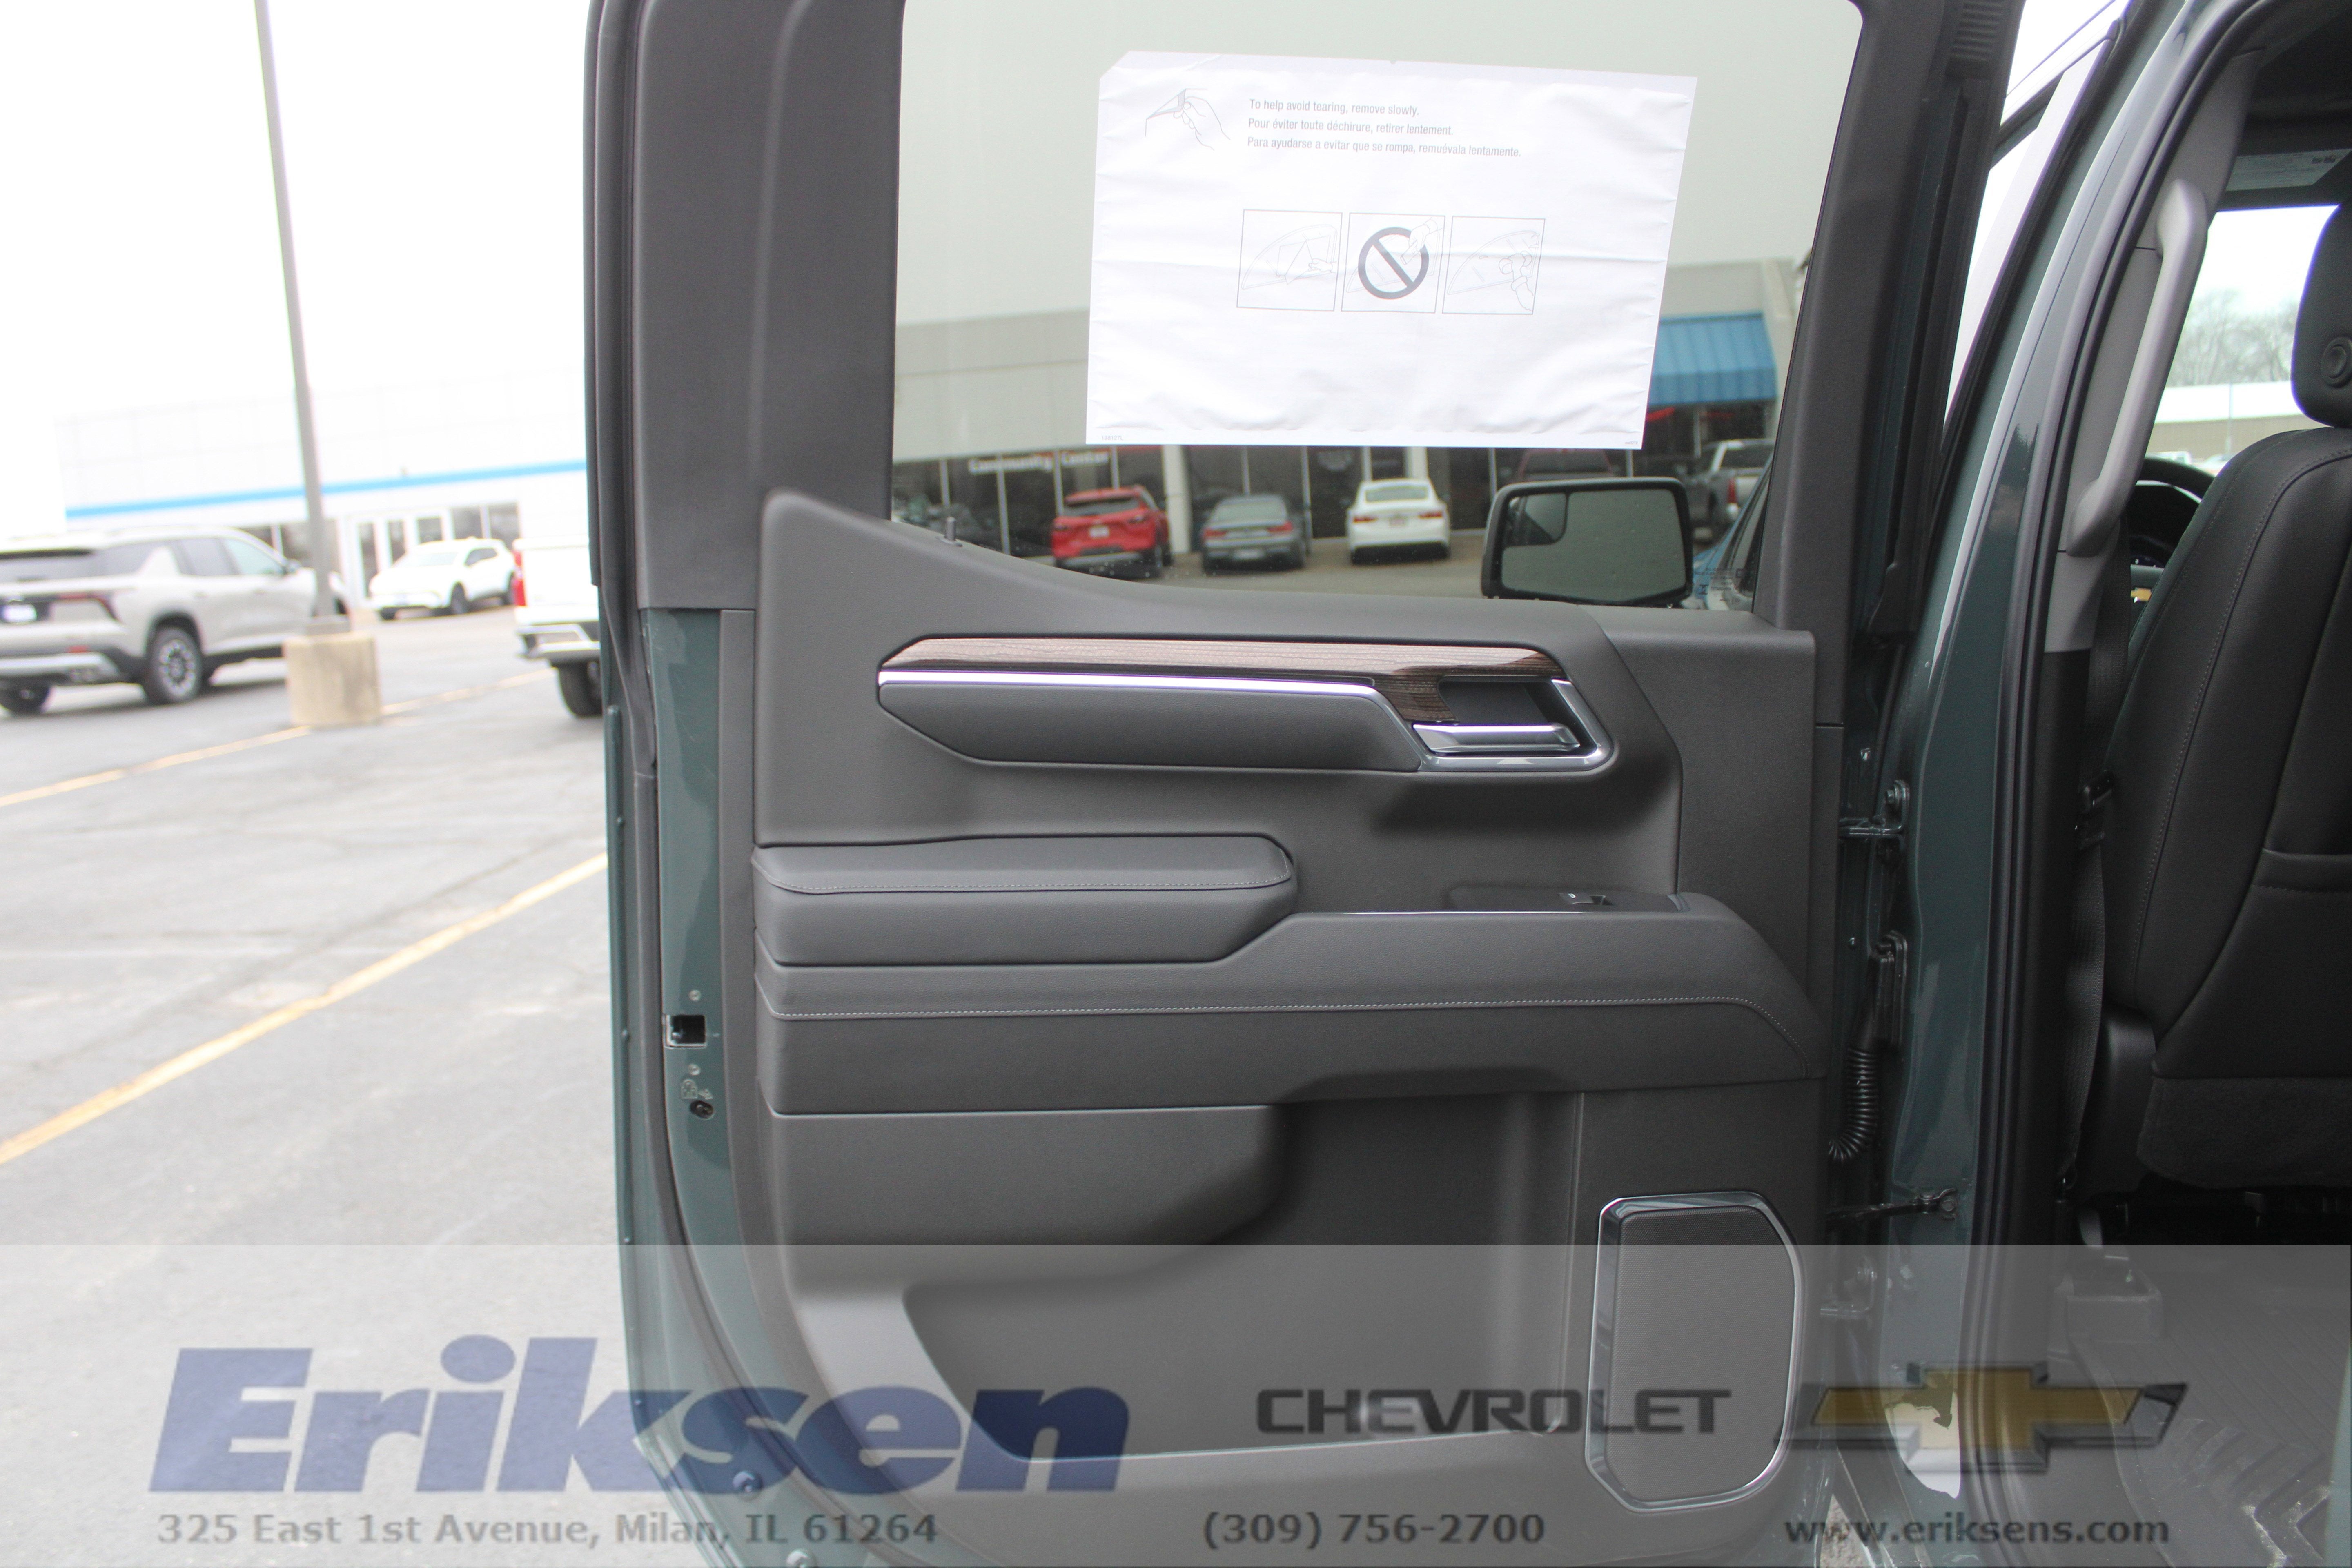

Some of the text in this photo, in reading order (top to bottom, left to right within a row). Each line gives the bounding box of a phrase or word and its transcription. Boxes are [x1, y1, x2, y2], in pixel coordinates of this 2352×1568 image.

[1249, 99, 1419, 117] To help avoid tearing, remove slowly.
[1248, 118, 1454, 135] Pour éviter toute déchirure, retirer lentement.
[1247, 137, 1521, 157] Para ayudarse a evitar que se rompa, remuévala lentamente.
